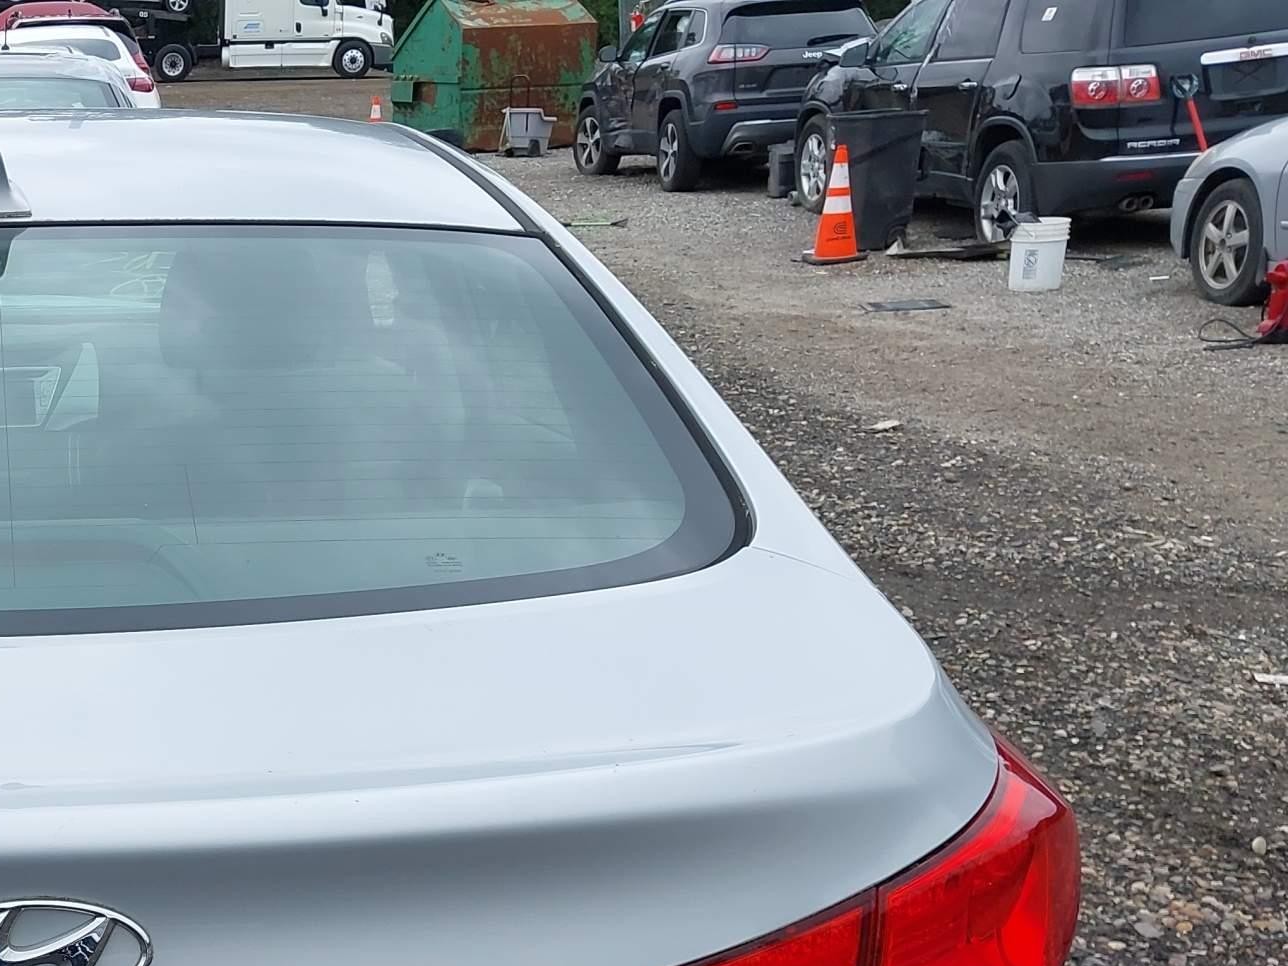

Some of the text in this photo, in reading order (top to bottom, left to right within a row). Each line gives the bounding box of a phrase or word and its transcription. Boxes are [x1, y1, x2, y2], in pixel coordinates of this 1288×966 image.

[802, 51, 823, 60] Jeep
[1239, 48, 1273, 61] GMC
[1127, 138, 1181, 149] ACADIA
